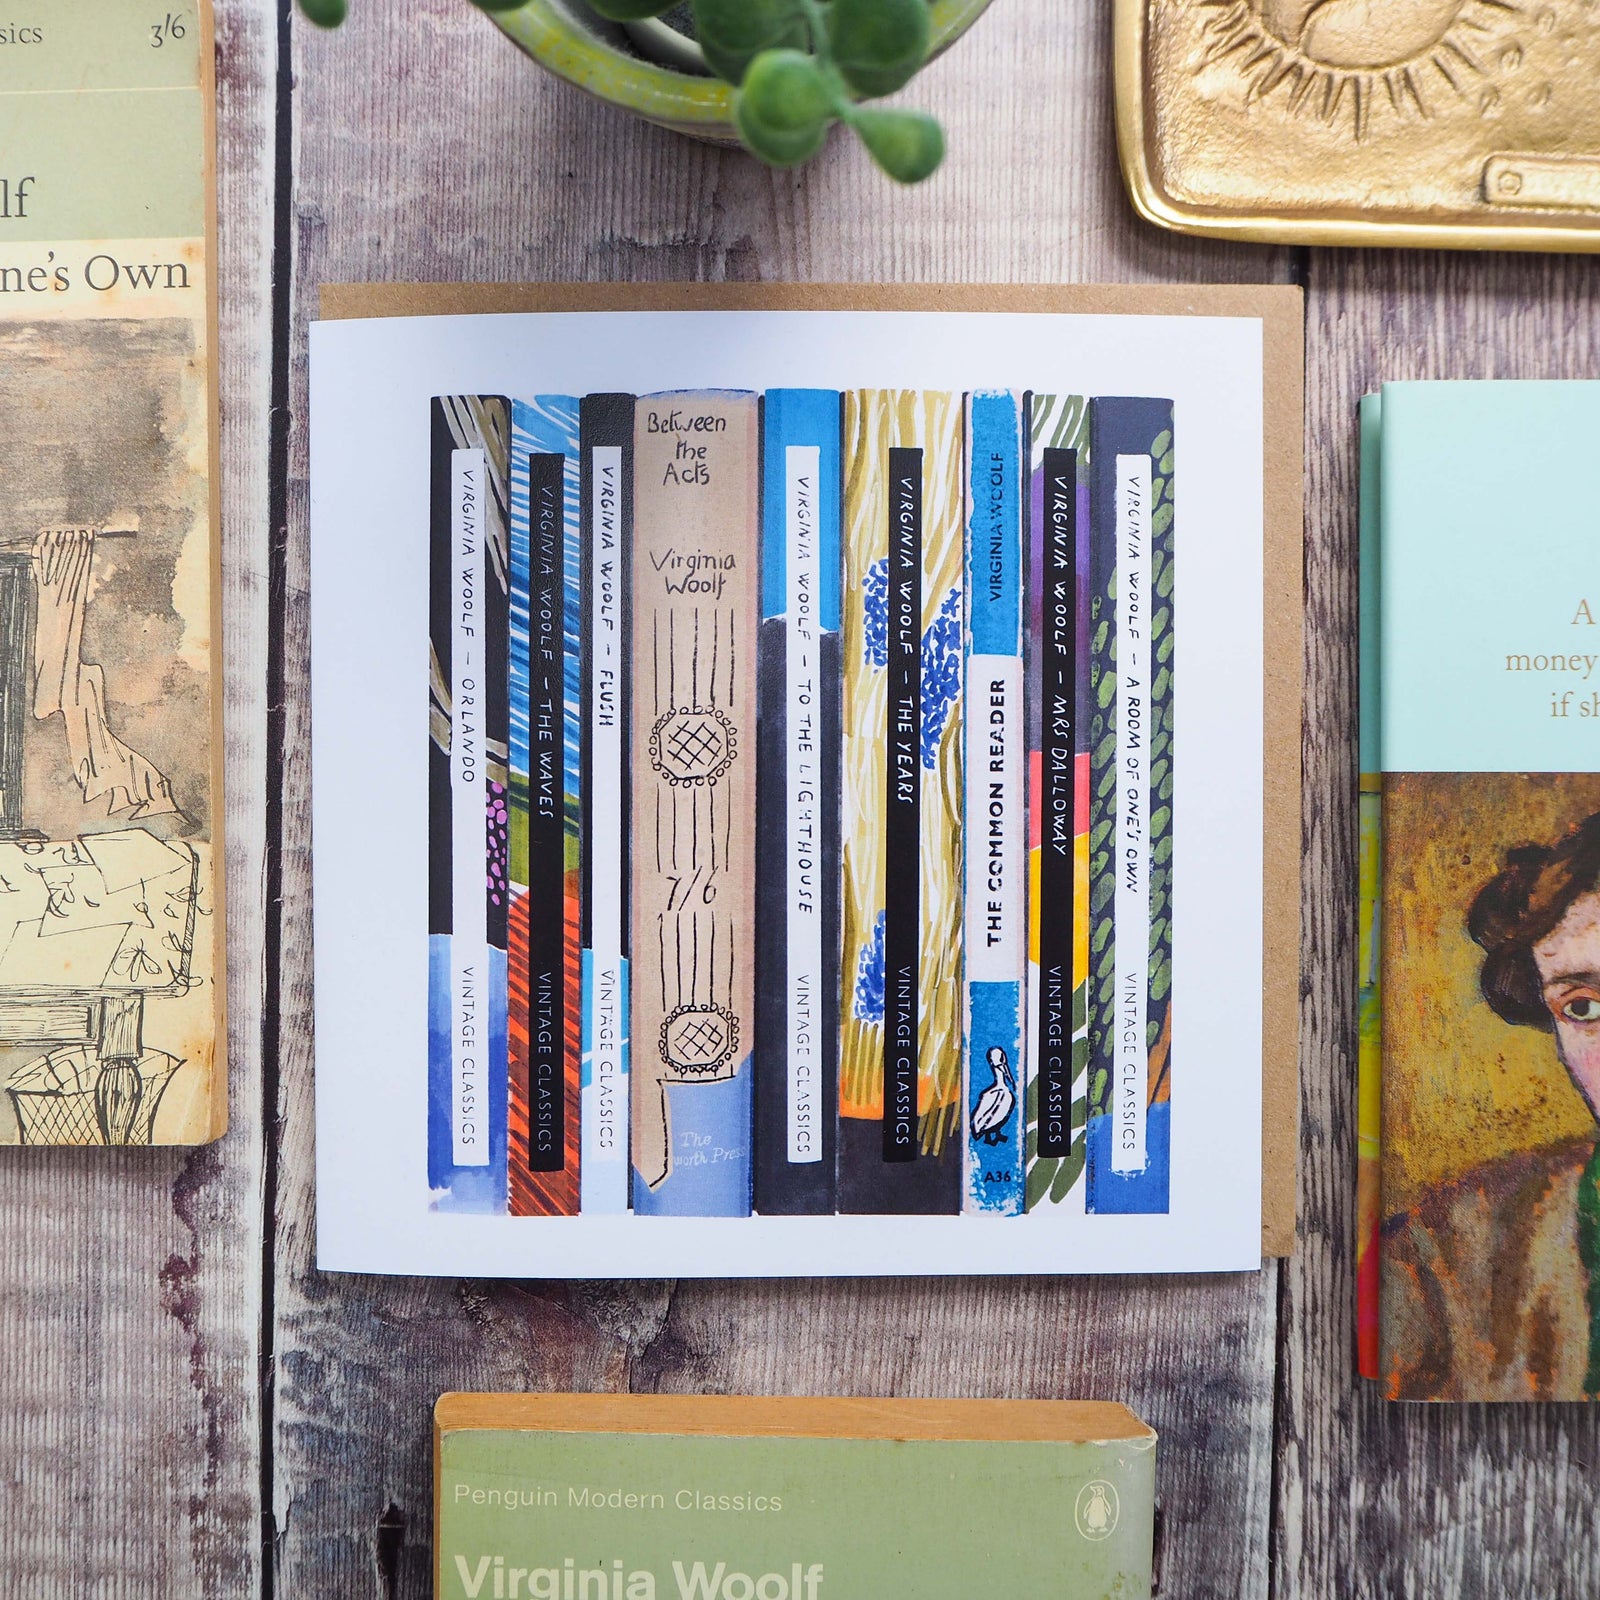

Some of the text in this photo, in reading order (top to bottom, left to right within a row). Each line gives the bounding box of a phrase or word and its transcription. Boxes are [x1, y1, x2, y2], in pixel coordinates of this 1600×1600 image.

[0, 250, 191, 292] ne's Own
[647, 409, 727, 434] Between
[675, 440, 708, 460] the
[662, 462, 710, 486] Acts
[462, 470, 475, 555] VIRGINIA
[540, 486, 554, 575] VIRGINIA
[600, 466, 615, 550] VIRGINIA
[797, 476, 811, 560] VIRGINIA
[900, 477, 914, 568] VIRGINIA
[1053, 476, 1068, 569] VIRGINIA
[1127, 476, 1141, 560] VIRGINIA
[600, 560, 614, 631] WOOLF
[649, 548, 736, 577] Virginia
[665, 572, 727, 600] Woolf
[989, 524, 1004, 602] VIRGINIA
[460, 567, 475, 637] WOOLF
[540, 588, 553, 661] WOOLF
[797, 572, 811, 640] WOOLF
[899, 580, 913, 655] WOOLF
[1053, 580, 1067, 655] WOOLF
[1128, 571, 1139, 639] WOOLF
[1570, 598, 1596, 625] A
[599, 669, 614, 726] FLUSH
[797, 679, 811, 705] TO
[1126, 676, 1140, 688] A
[1505, 654, 1599, 680] money
[461, 678, 475, 782] ORLANDO
[538, 698, 553, 741] THE
[797, 716, 813, 752] THE
[896, 696, 914, 734] THE
[1051, 694, 1070, 739] MRS
[1126, 696, 1141, 748] ROOM
[1551, 690, 1574, 717] if
[539, 751, 554, 818] WAVES
[896, 741, 914, 804] YEARS
[1051, 748, 1067, 855] DALLOWAY
[1126, 757, 1140, 780] OF
[797, 764, 813, 914] LIGHTHOUSE
[987, 679, 1005, 947] THE COMMON READER
[1126, 788, 1140, 842] ONE'S
[666, 866, 719, 911] 7/6
[1126, 850, 1138, 893] OWN
[462, 966, 475, 1145] VINTAGE CLASSICS
[538, 972, 552, 1151] VINTAGE CLASSICS
[600, 970, 614, 1148] VINTAGE CLASSICS
[797, 974, 810, 1152] VINTAGE CLASSICS
[896, 966, 911, 1144] VINTAGE CLASSICS
[1048, 965, 1062, 1143] VINTAGE CLASSICS
[1122, 972, 1136, 1150] VINTAGE CLASSICS
[681, 1131, 712, 1147] The
[455, 1484, 782, 1511] Penguin Modern Classics
[454, 1555, 824, 1600] Virginia Woolf
